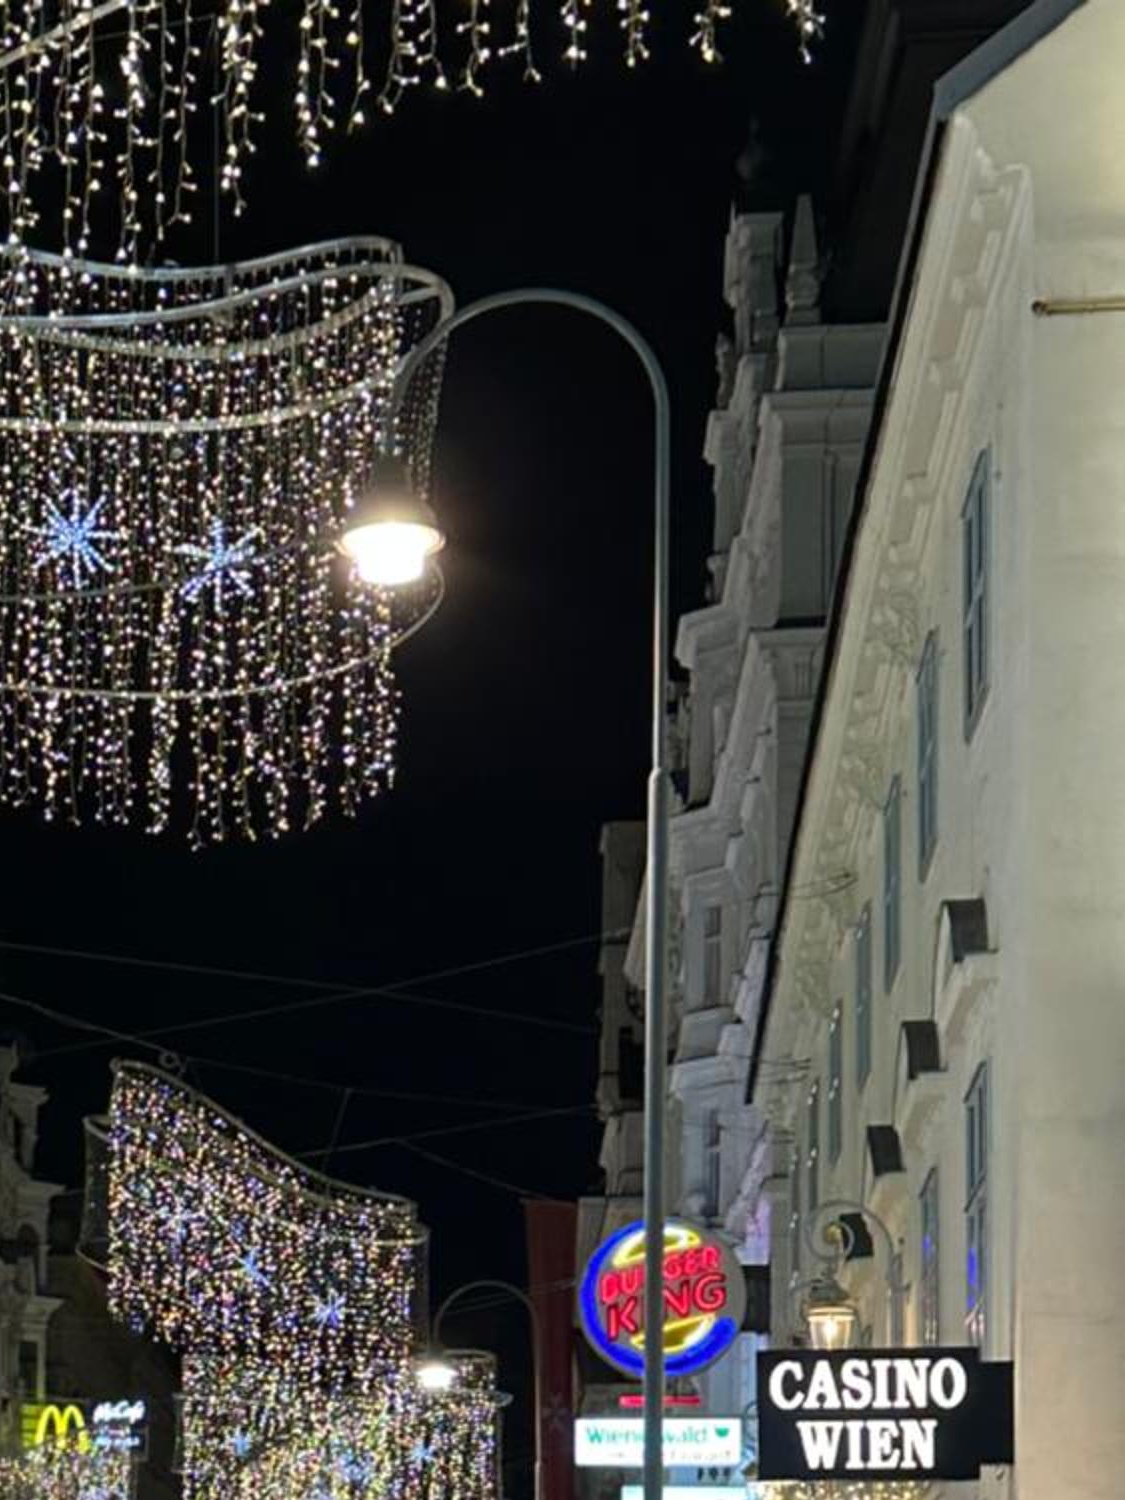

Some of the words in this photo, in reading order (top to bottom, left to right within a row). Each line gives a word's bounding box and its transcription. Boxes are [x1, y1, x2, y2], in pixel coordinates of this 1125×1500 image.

[600, 1247, 720, 1304] BUGER
[607, 1273, 727, 1343] KNG
[769, 1358, 967, 1410] CASINO
[795, 1419, 938, 1470] WIEN
